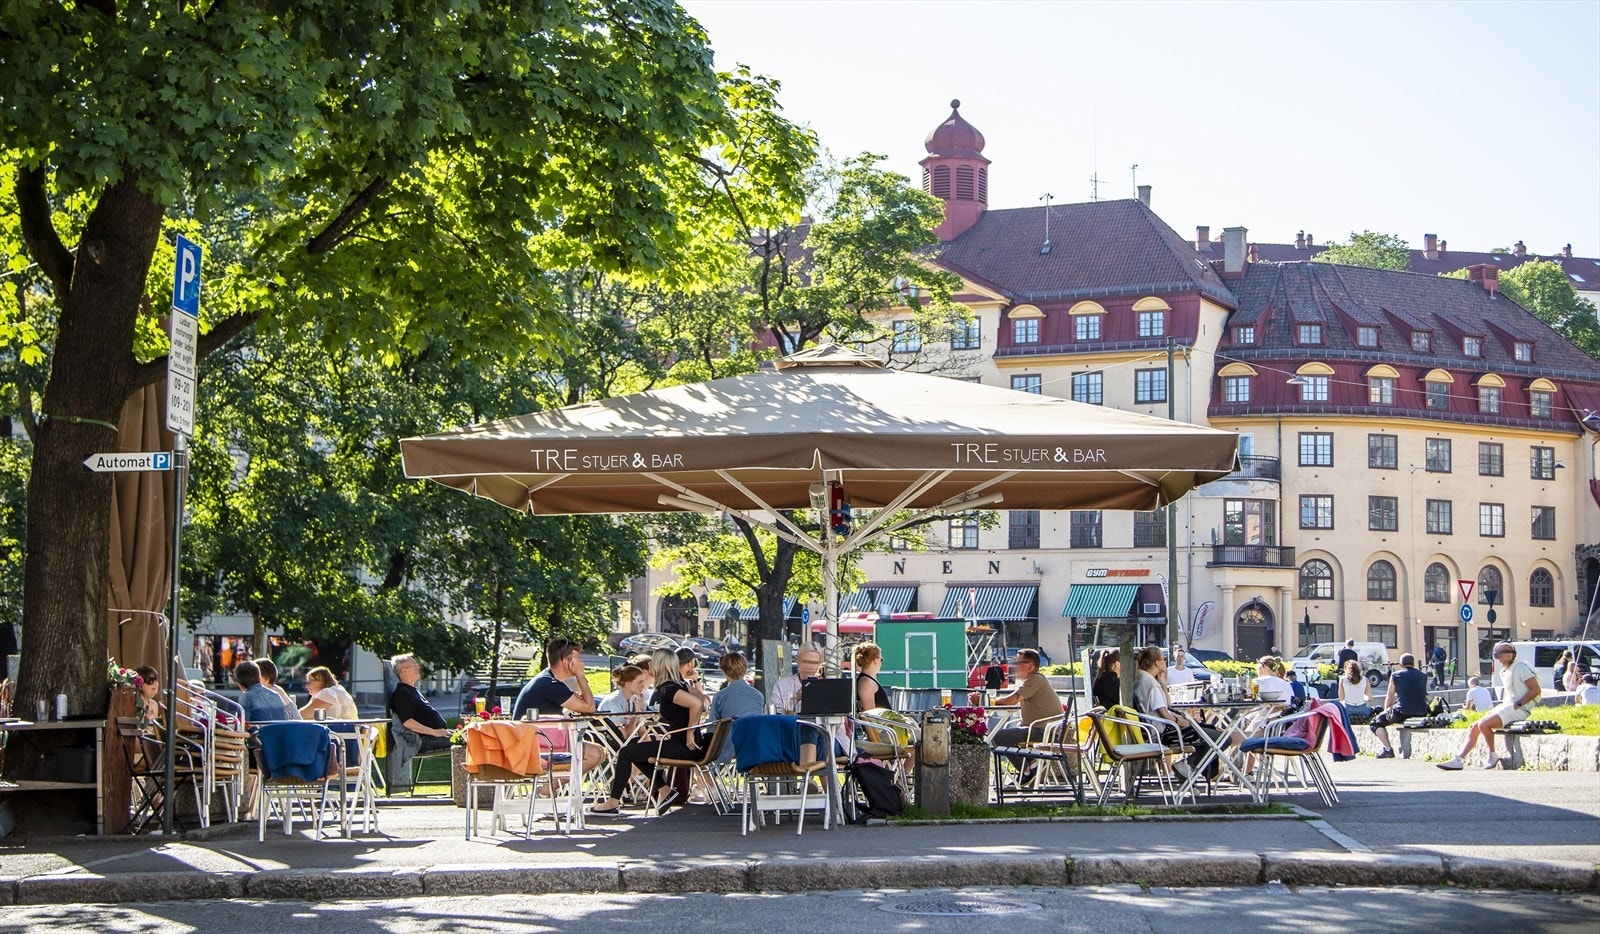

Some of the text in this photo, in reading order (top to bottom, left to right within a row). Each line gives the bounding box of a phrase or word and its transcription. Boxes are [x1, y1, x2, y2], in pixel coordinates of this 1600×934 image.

[180, 248, 195, 301] P
[174, 377, 190, 394] 09-20
[96, 455, 166, 468] Automat P
[530, 449, 578, 471] TRE
[632, 452, 648, 469] &
[651, 453, 685, 468] BAR
[951, 443, 999, 463] TRE
[1053, 446, 1069, 463] &
[1073, 448, 1107, 463] BAR
